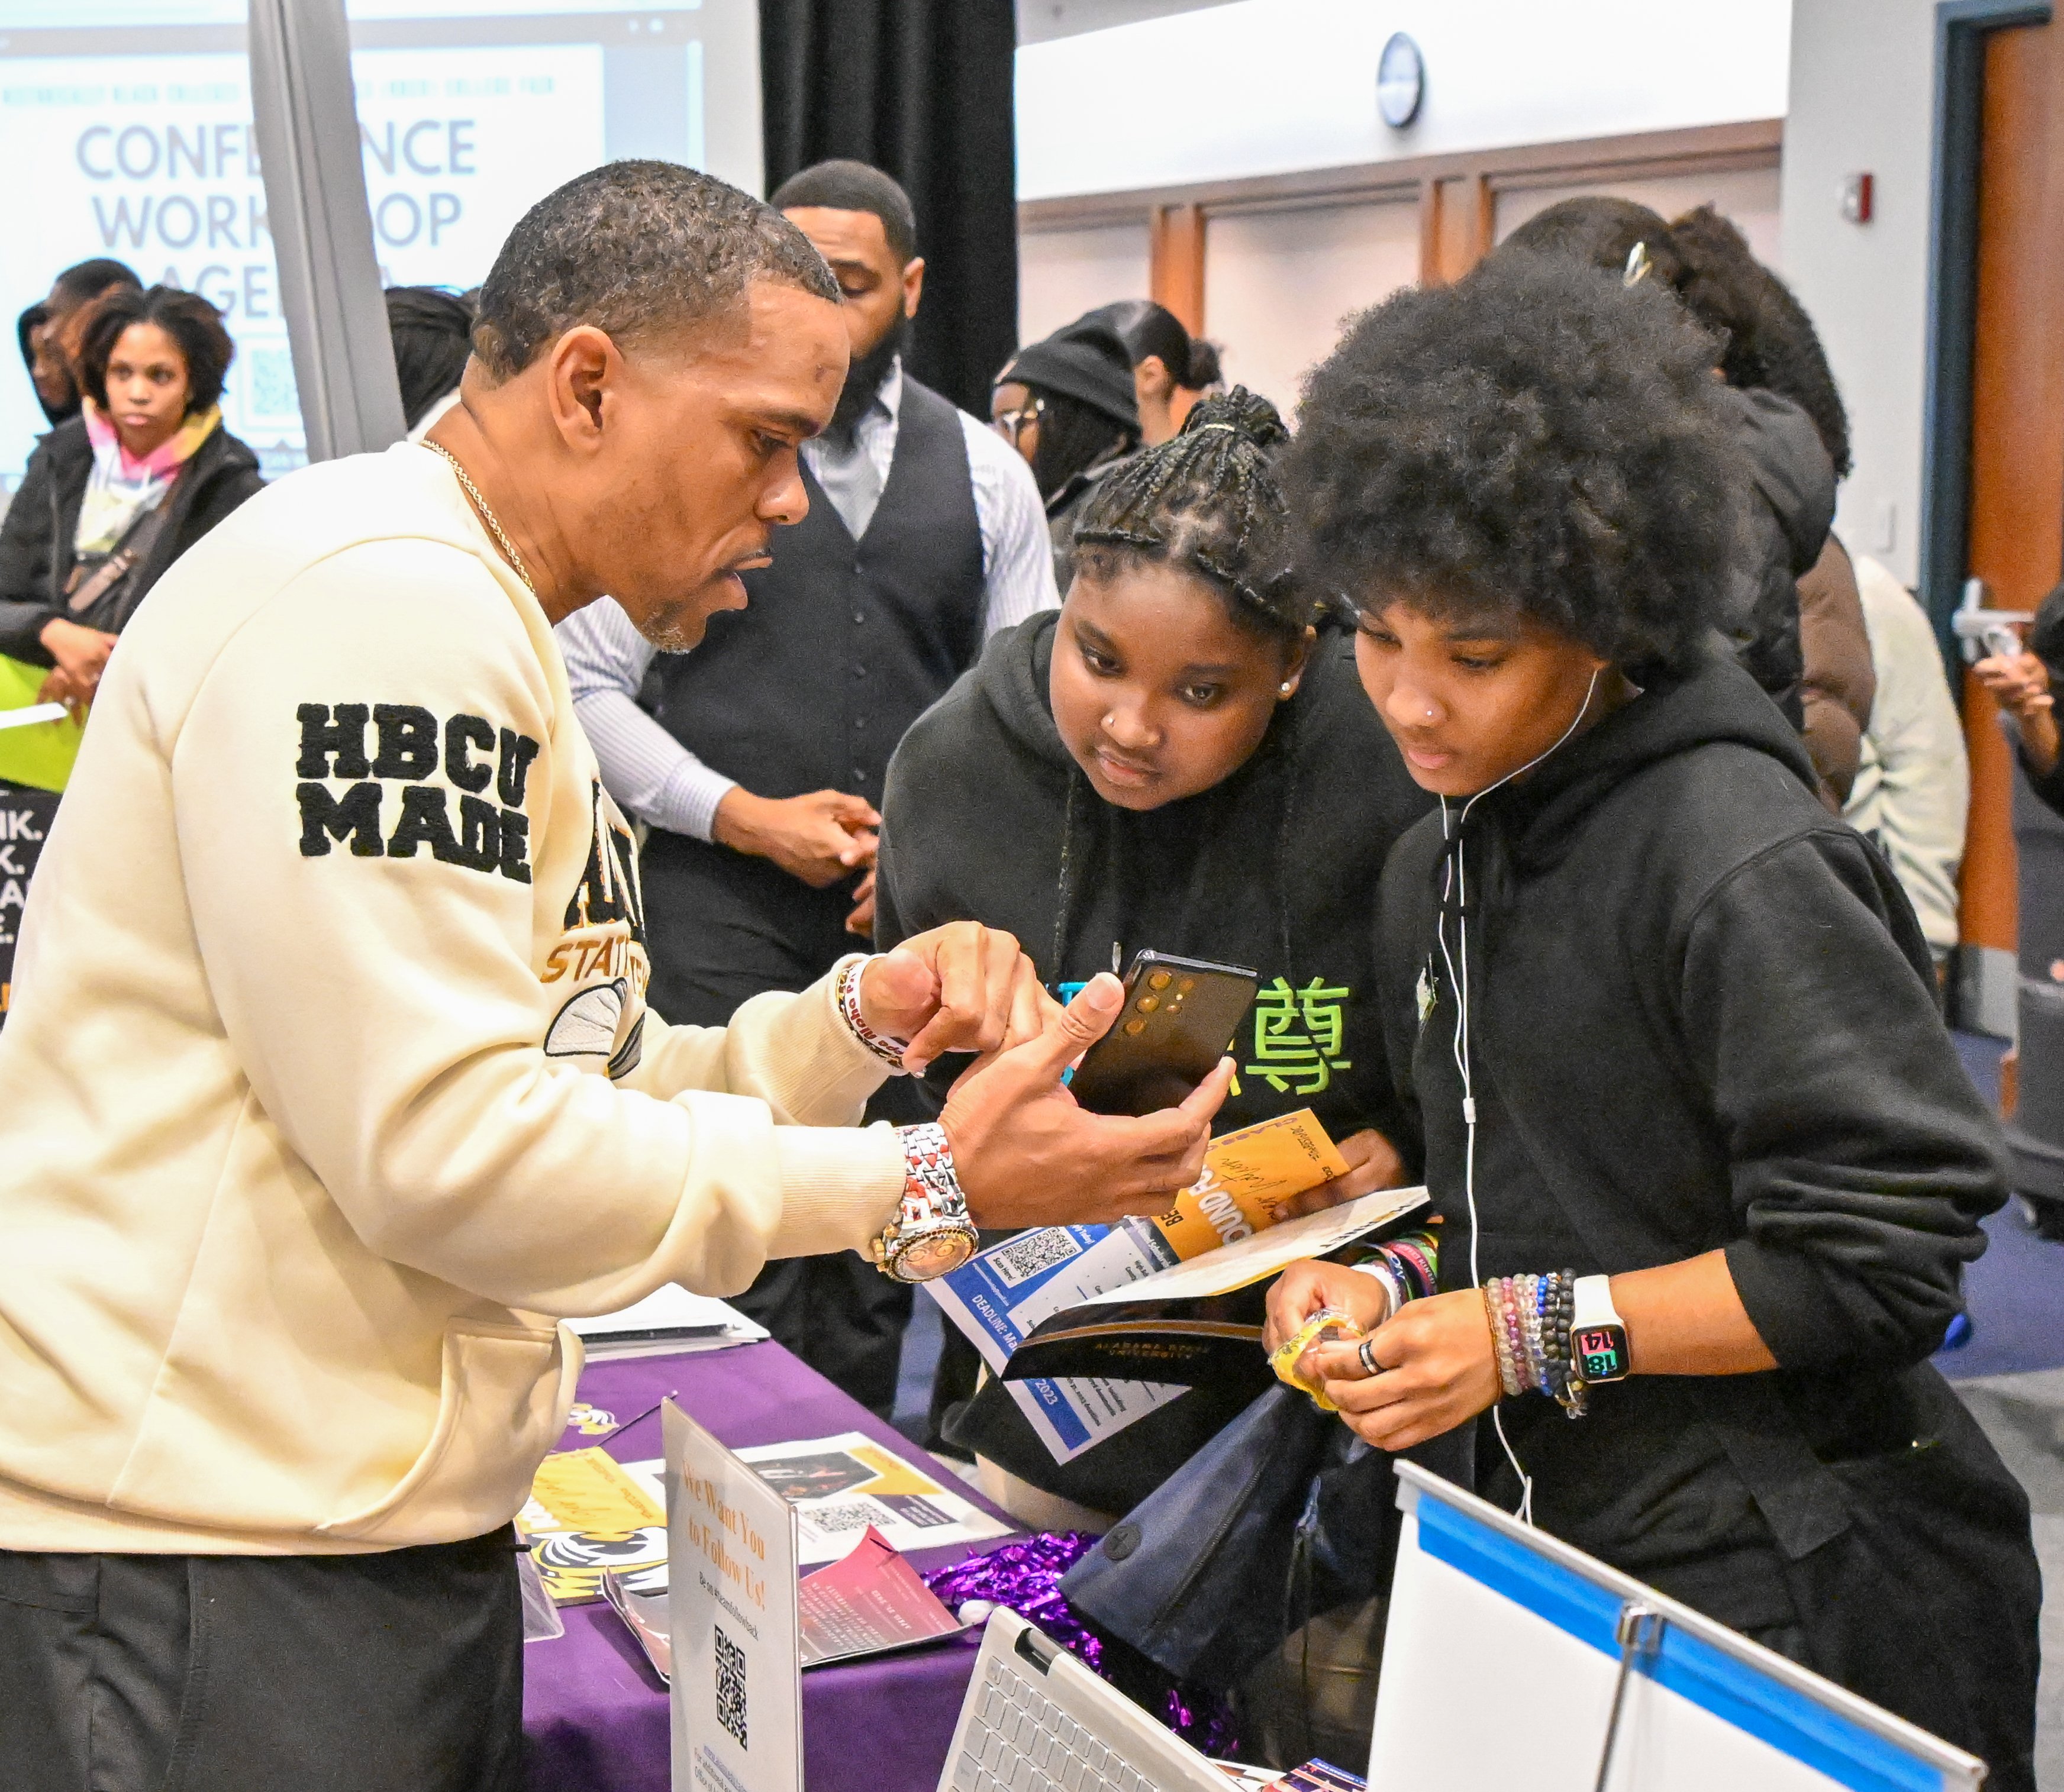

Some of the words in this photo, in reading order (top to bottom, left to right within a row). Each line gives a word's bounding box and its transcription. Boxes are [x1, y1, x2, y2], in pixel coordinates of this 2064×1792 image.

[77, 120, 476, 180] CONFENCE
[92, 193, 462, 250] WORKOP
[296, 703, 540, 807] HBCU
[296, 782, 532, 884] MADE
[1188, 1163, 1221, 1197] FO
[1160, 1207, 1184, 1228] BE
[1198, 1190, 1252, 1246] OUND
[1034, 1378, 1059, 1406] 2023
[683, 1458, 701, 1502] We
[705, 1479, 737, 1535] Want
[740, 1510, 765, 1561] You
[689, 1515, 699, 1546] to
[702, 1523, 740, 1587] Follow
[745, 1566, 766, 1612] Us!
